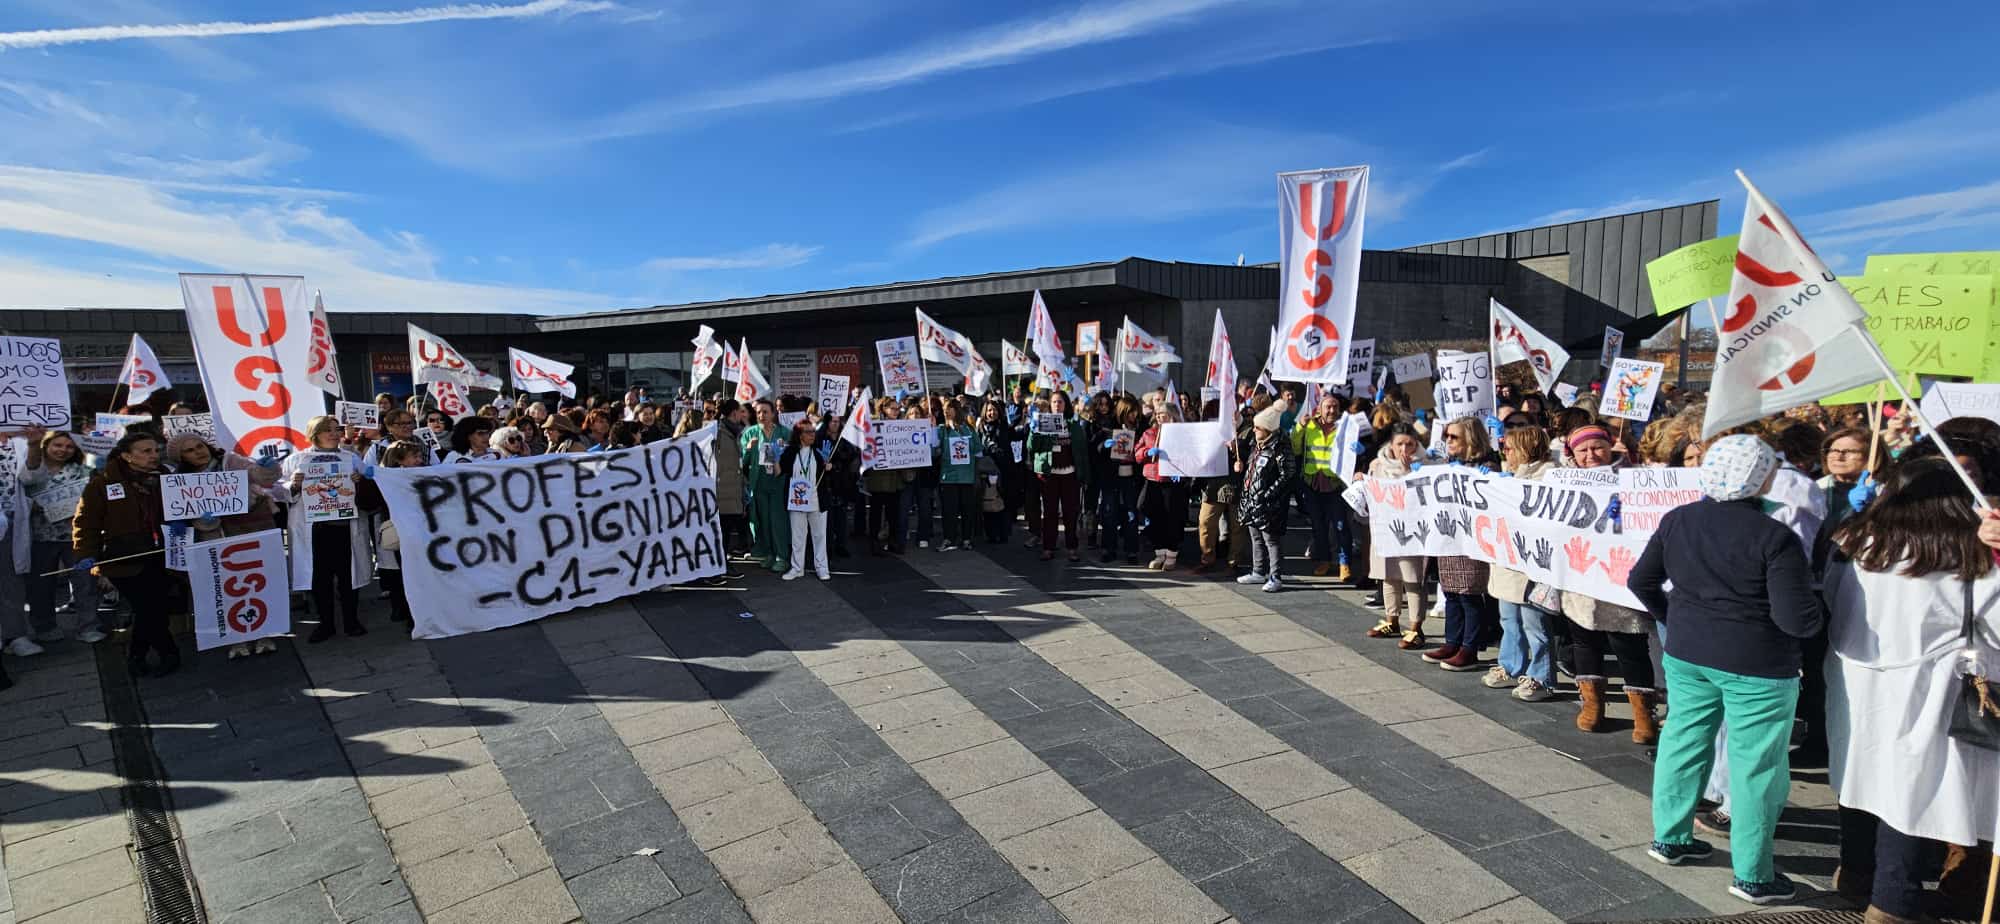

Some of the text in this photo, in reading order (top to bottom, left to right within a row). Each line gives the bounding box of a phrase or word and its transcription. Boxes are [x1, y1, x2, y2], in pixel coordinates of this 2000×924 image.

[1287, 180, 1349, 371] USO
[1850, 285, 1943, 307] CAES
[1907, 339, 1945, 368] YA
[1440, 355, 1488, 384] RT. 76
[911, 432, 927, 445] C1
[166, 473, 239, 487] SIN TCAES
[1633, 469, 1658, 488] POR
[1663, 469, 1678, 488] UN
[181, 485, 238, 499] NO HAY
[1405, 473, 1490, 511] TCAES
[170, 498, 243, 516] SANIDAD
[427, 528, 517, 572] CON
[220, 540, 268, 634] USO
